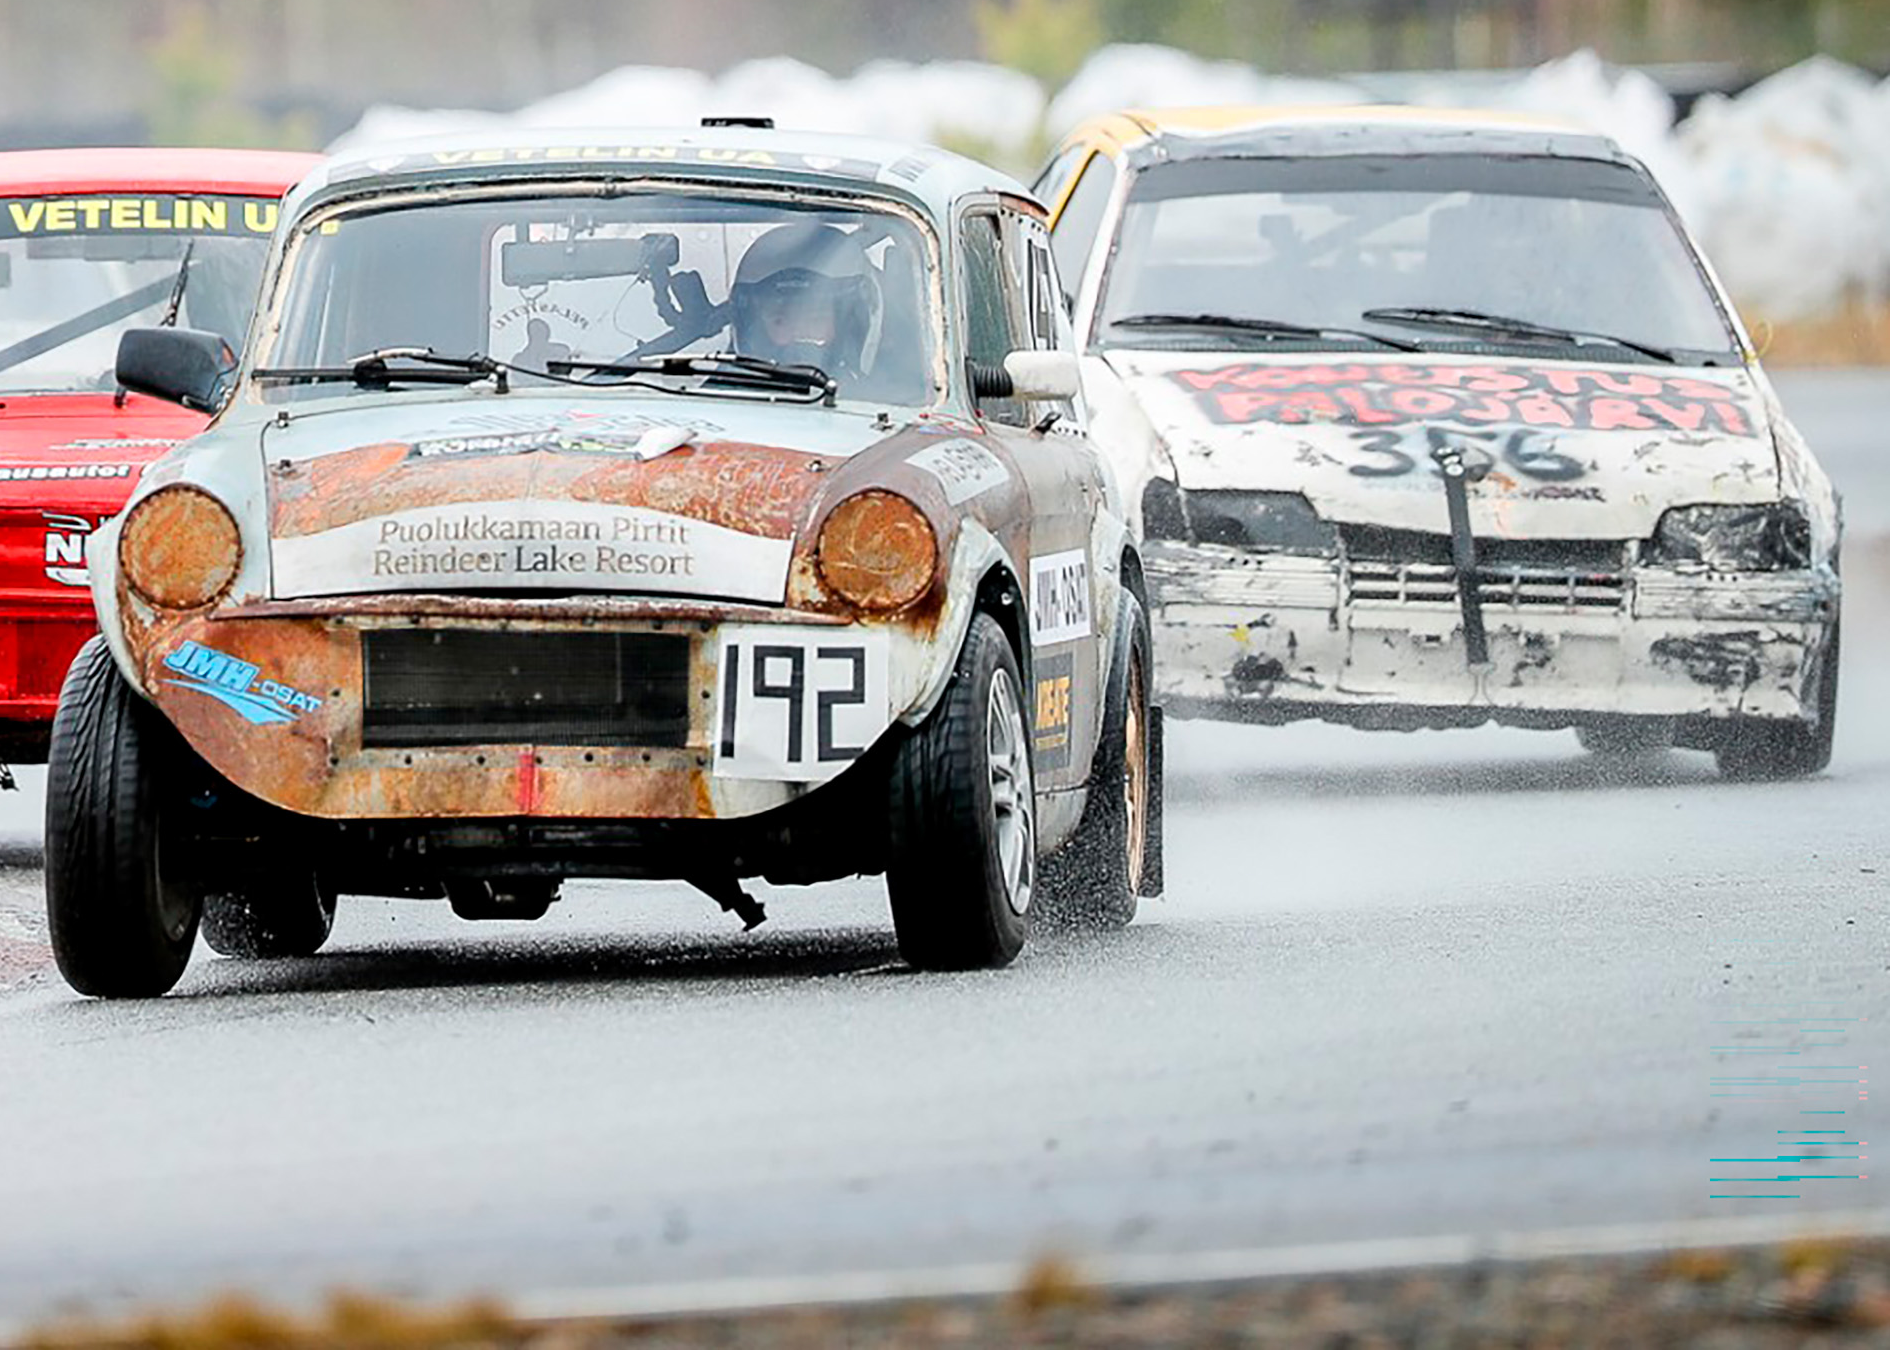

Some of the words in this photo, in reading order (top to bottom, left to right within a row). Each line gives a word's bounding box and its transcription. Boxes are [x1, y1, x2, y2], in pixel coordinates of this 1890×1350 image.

[433, 145, 676, 164] VETELIN
[697, 148, 777, 165] UA
[8, 199, 227, 232] VETELIN
[244, 202, 278, 233] U
[1200, 387, 1758, 440] PALOJÄRVI
[1348, 427, 1587, 481] 356
[378, 515, 601, 545] Puolukkamaan
[612, 514, 690, 545] Pirtit
[373, 546, 507, 576] Reindeer
[515, 545, 586, 574] Lake
[596, 548, 694, 576] Resort
[163, 641, 322, 713] JMH-OSAT
[720, 644, 866, 763] 192
